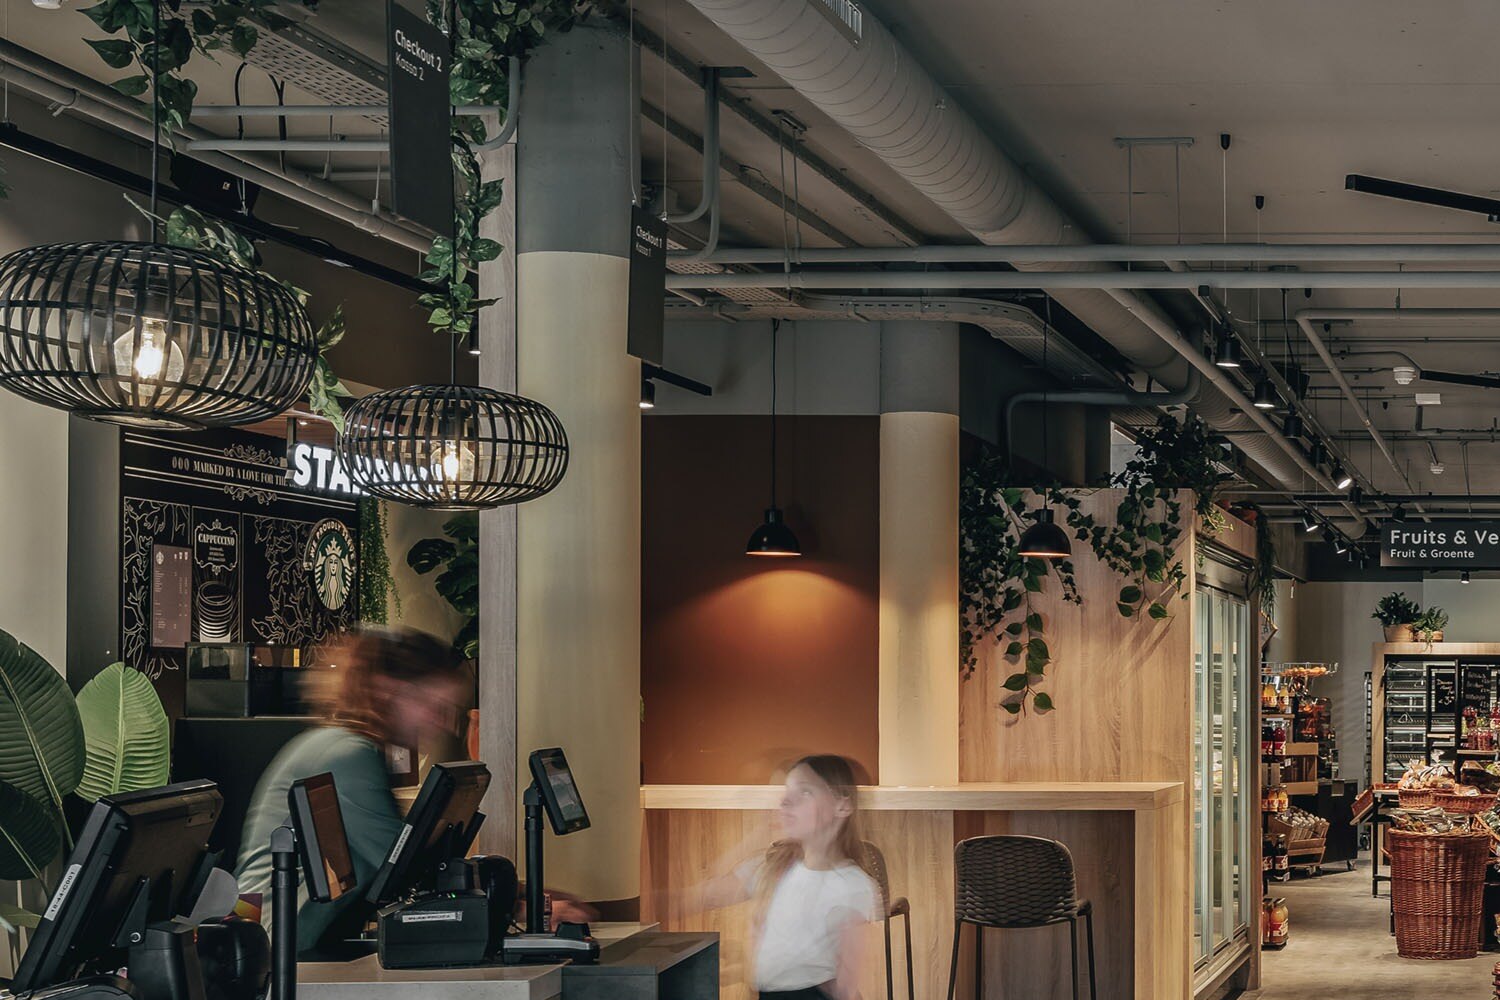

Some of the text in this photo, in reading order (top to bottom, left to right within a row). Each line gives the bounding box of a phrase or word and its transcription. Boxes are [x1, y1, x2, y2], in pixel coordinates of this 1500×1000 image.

[395, 29, 442, 73] Checkout 2
[395, 51, 424, 81] Kassa 2
[636, 225, 658, 247] Checkout
[193, 461, 224, 477] MARKED
[225, 467, 235, 478] BY
[237, 468, 243, 479] A
[242, 470, 260, 483] LOVE
[260, 472, 274, 485] FOR
[198, 533, 235, 547] CAPPUCCINO
[315, 521, 341, 540] PROUDLY
[1390, 529, 1447, 546] Fruits
[1453, 529, 1468, 546] &
[1390, 548, 1475, 559] Fruit & Groente
